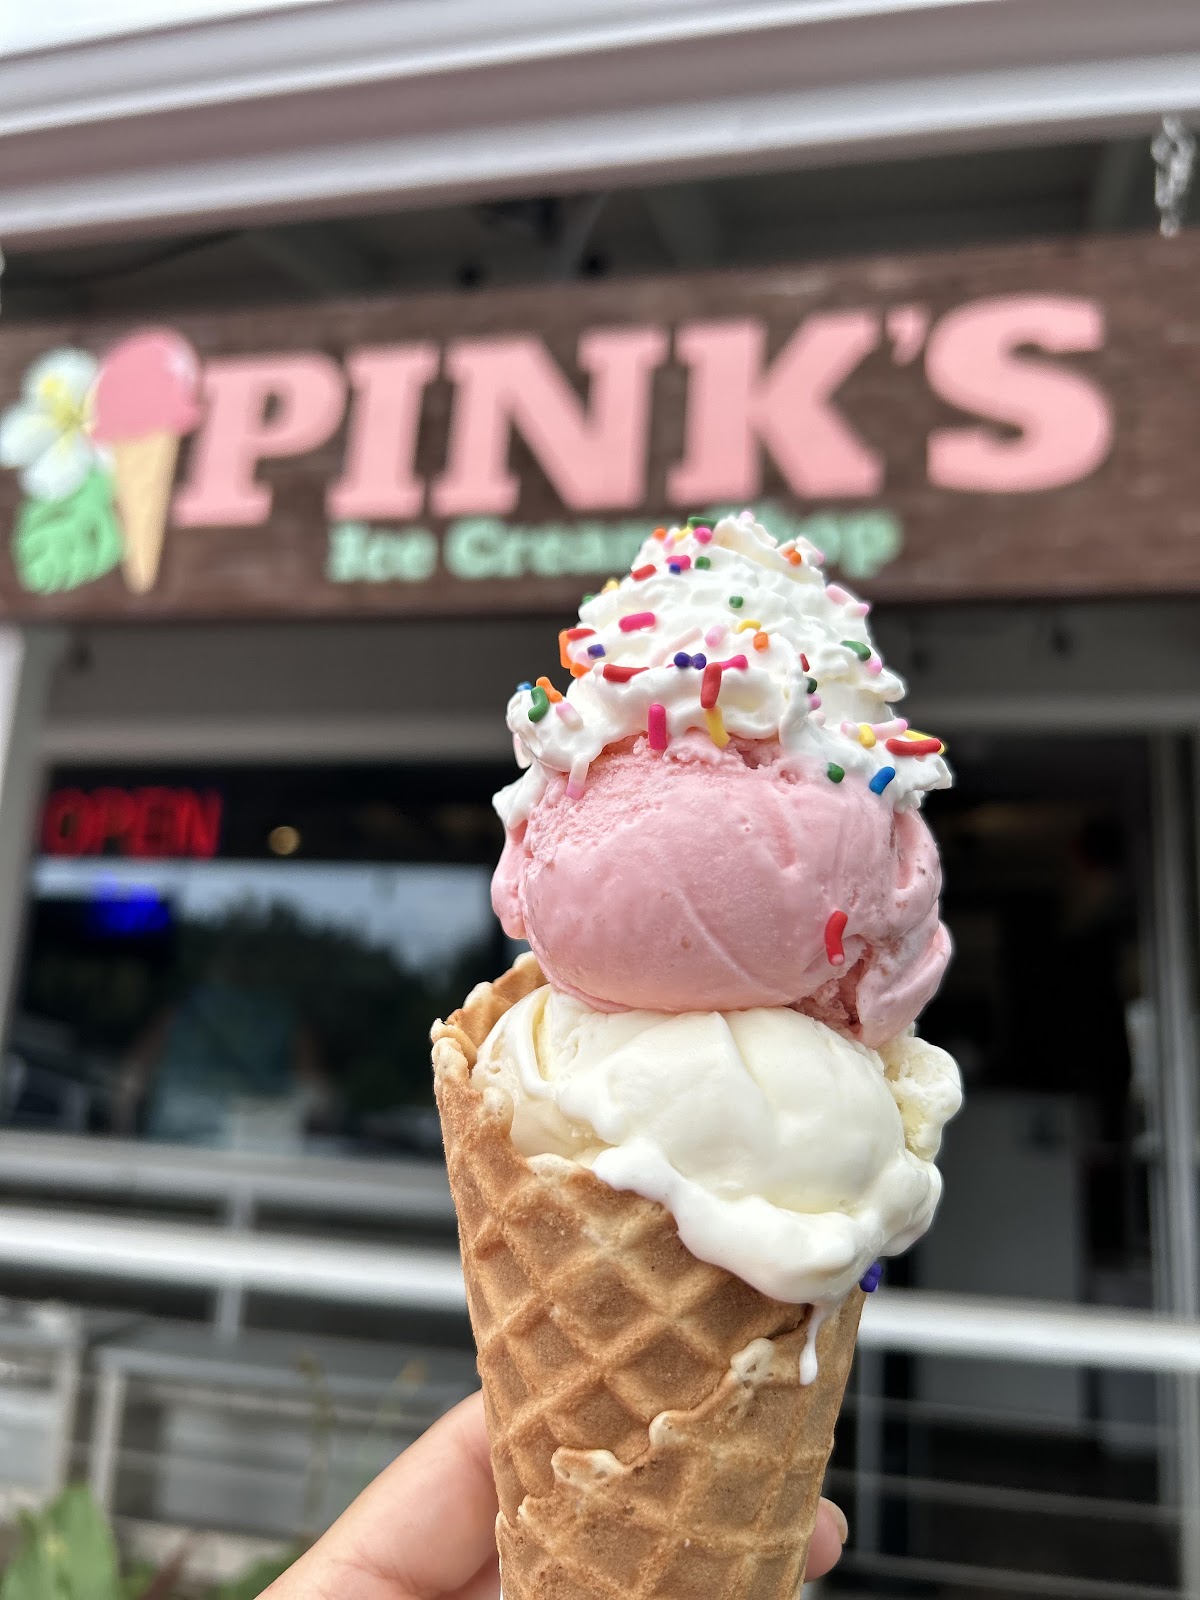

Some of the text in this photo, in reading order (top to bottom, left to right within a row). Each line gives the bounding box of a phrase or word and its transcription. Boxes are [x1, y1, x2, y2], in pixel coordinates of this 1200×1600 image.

[174, 296, 1111, 526] PINK'S
[328, 521, 437, 581] Ice
[43, 788, 221, 860] OPEN
